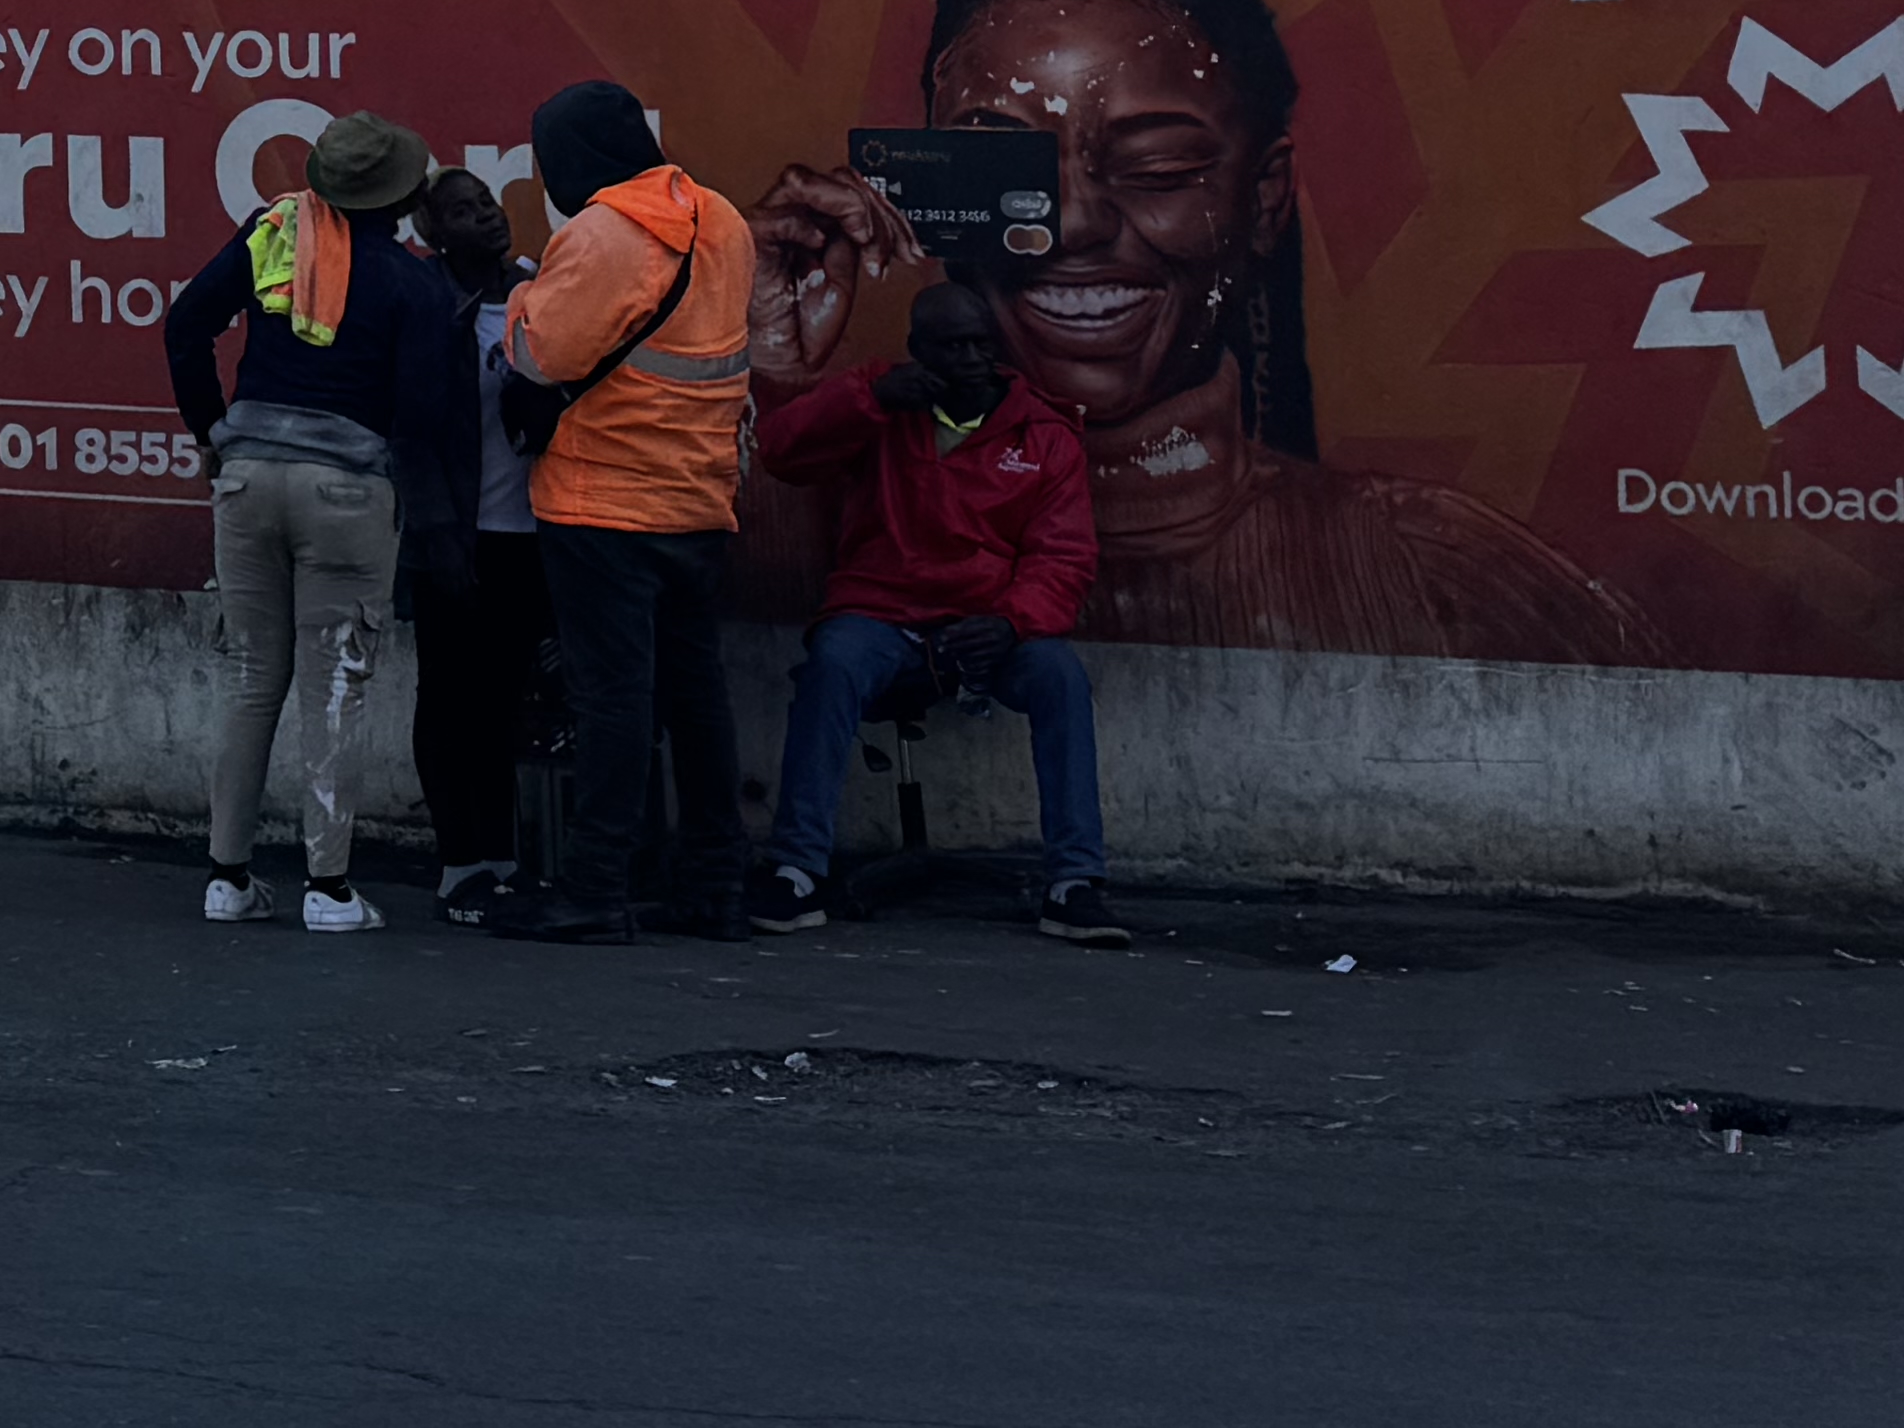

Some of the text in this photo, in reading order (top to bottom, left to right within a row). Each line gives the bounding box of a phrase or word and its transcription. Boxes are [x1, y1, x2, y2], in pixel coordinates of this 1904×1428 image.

[68, 26, 162, 78] on
[180, 27, 356, 94] your
[74, 428, 201, 480] 8555
[1616, 467, 1904, 524] Download
